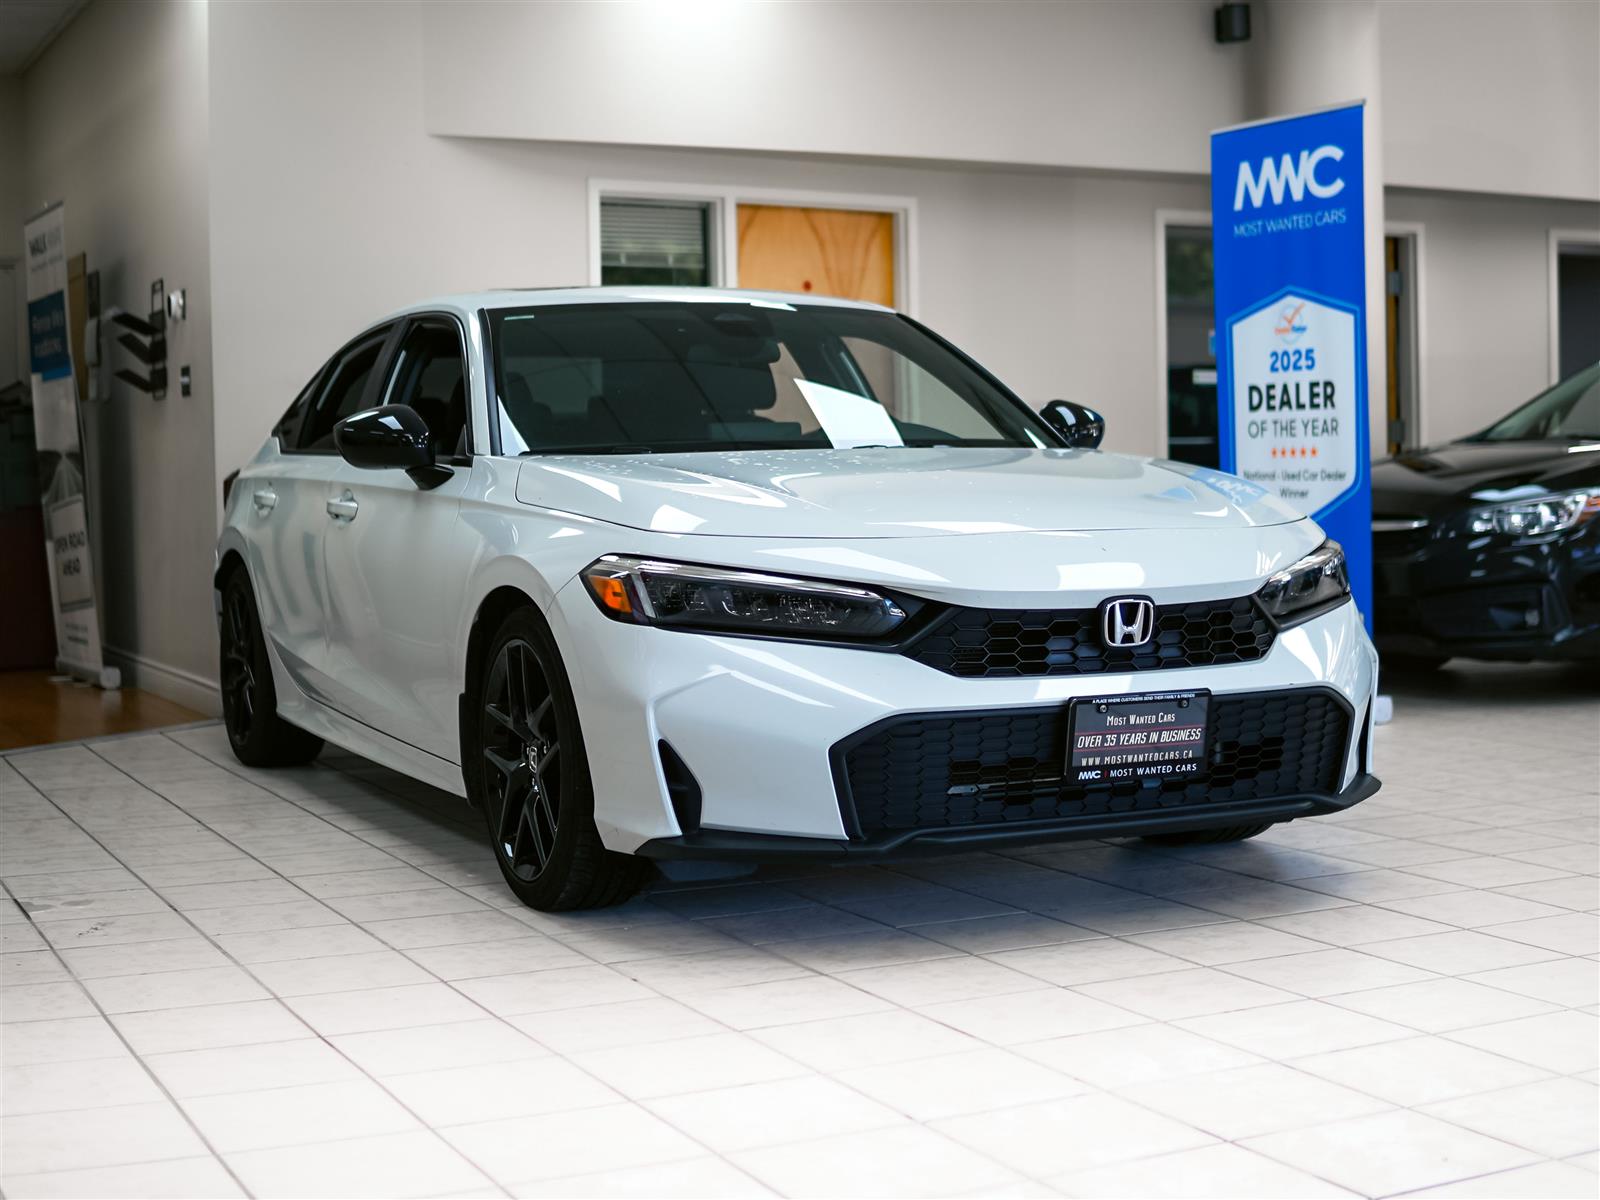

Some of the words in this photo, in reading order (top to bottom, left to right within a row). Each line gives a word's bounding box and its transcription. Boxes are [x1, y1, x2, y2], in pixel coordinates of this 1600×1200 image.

[1233, 145, 1345, 211] MWC
[1233, 220, 1262, 238] MOST
[1265, 214, 1313, 233] WANTED
[1314, 208, 1347, 227] CARS
[1269, 348, 1316, 373] 2025
[1248, 380, 1336, 412] DEALER
[1247, 420, 1268, 439] OF
[1272, 419, 1297, 438] THE
[1301, 418, 1339, 437] YEAR
[1243, 469, 1276, 481] National
[1281, 468, 1301, 481] Used
[1302, 468, 1318, 481] Car
[1320, 468, 1347, 480] Dealer
[1279, 487, 1309, 499] Winner
[1077, 734, 1102, 748] OVER
[1104, 734, 1117, 747] 35
[1119, 732, 1147, 745] YEARS
[1149, 731, 1159, 743] IN
[1160, 728, 1202, 742] BUSINESS
[1081, 750, 1193, 766] WWW.MOSTWANTEDCARS.CA
[1078, 770, 1101, 780] MWC
[1109, 768, 1133, 777] MOST
[1136, 765, 1173, 776] WANTED
[1175, 763, 1197, 773] CARS
